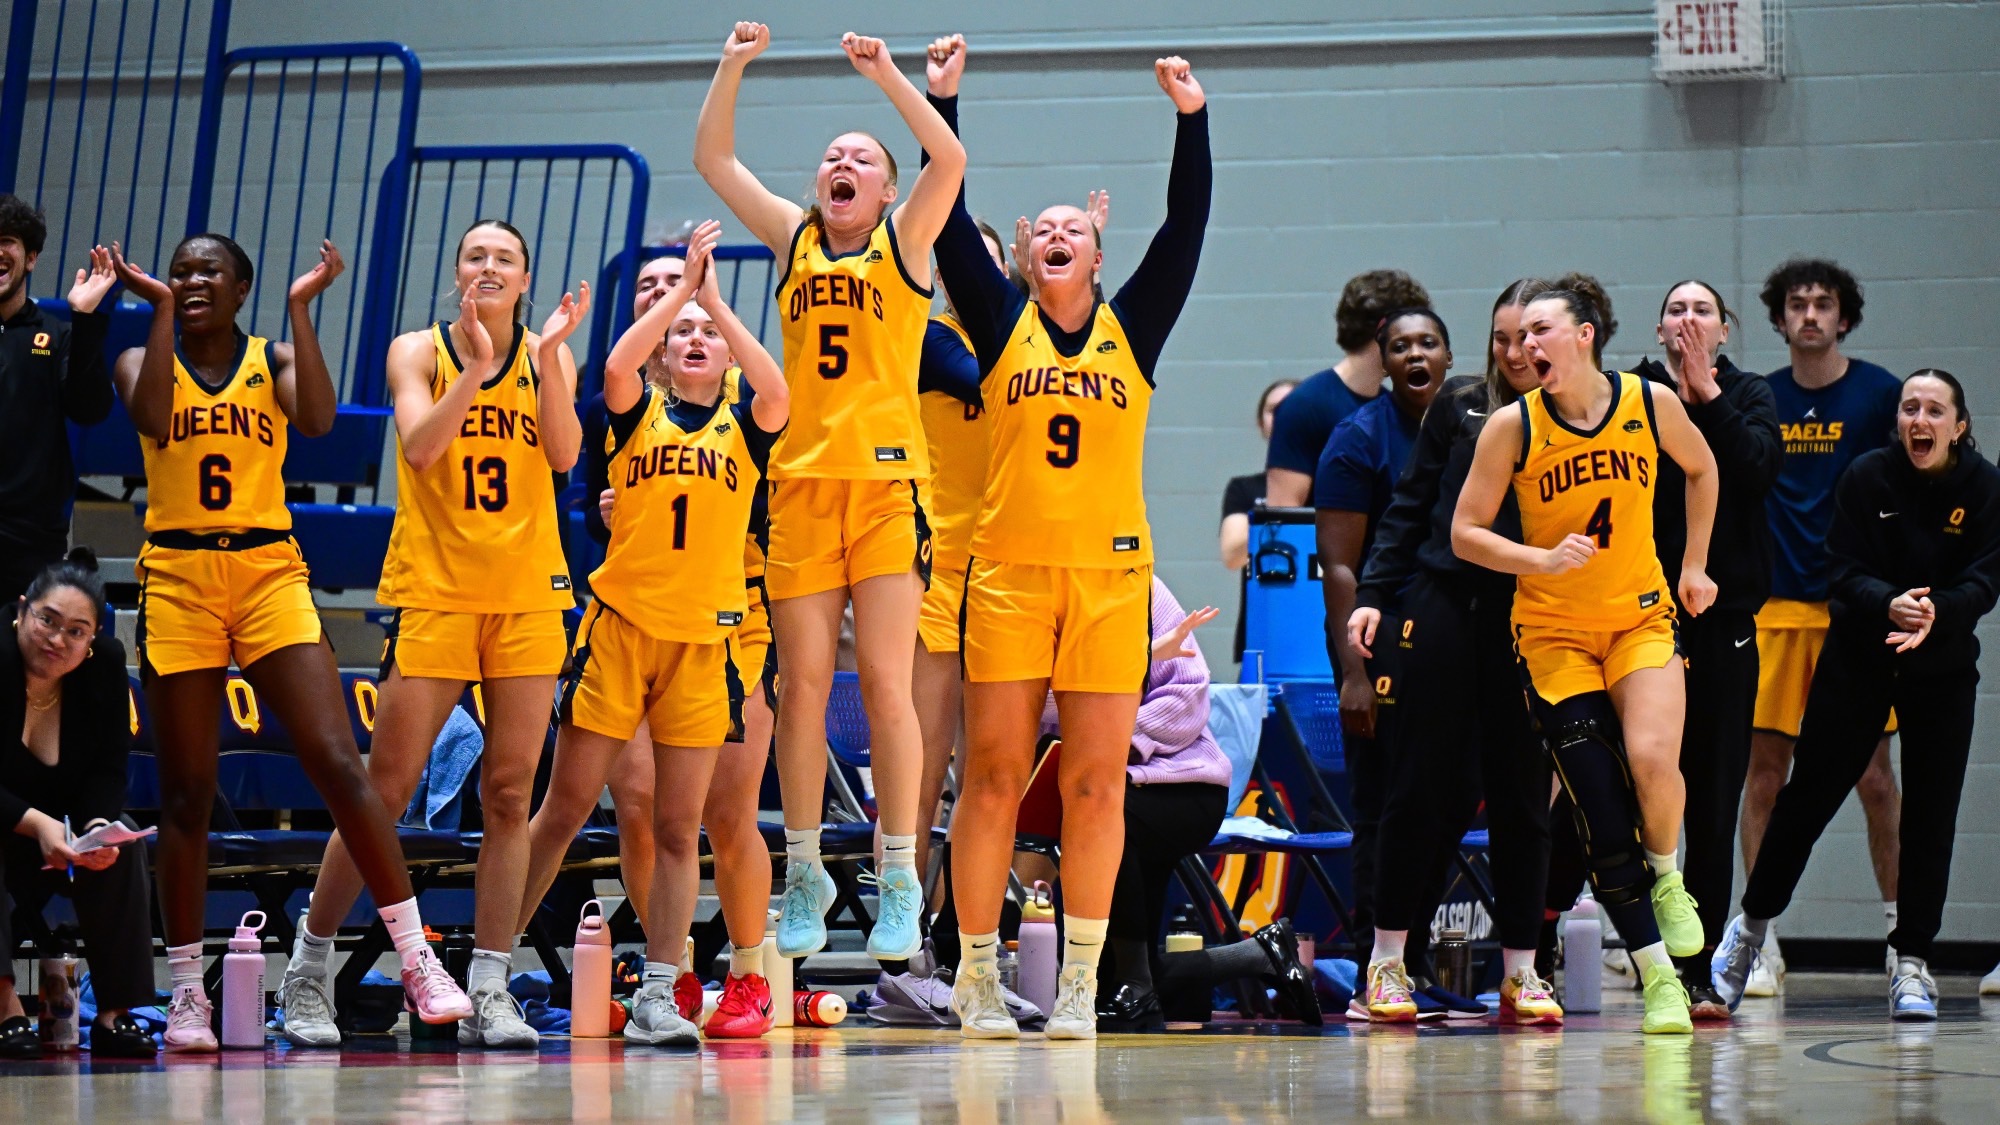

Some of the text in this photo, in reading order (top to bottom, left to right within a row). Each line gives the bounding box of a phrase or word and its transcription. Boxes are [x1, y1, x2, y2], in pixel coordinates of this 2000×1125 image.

[1676, 2, 1739, 55] EXIT
[790, 273, 884, 323] QUEEN'S
[818, 324, 849, 380] 5
[1007, 366, 1127, 410] QUEEN'S
[457, 404, 538, 447] EEN'S
[1046, 413, 1081, 469] 9
[1785, 442, 1834, 453] ASKETBALL
[199, 453, 232, 511] 6
[463, 456, 508, 512] 13
[626, 444, 738, 492] QUEEN'S
[1539, 449, 1648, 503] QUEEN'S
[671, 493, 688, 551] 1
[1585, 497, 1613, 549] 4
[225, 676, 262, 736] Q
[257, 974, 265, 1027] lululemon
